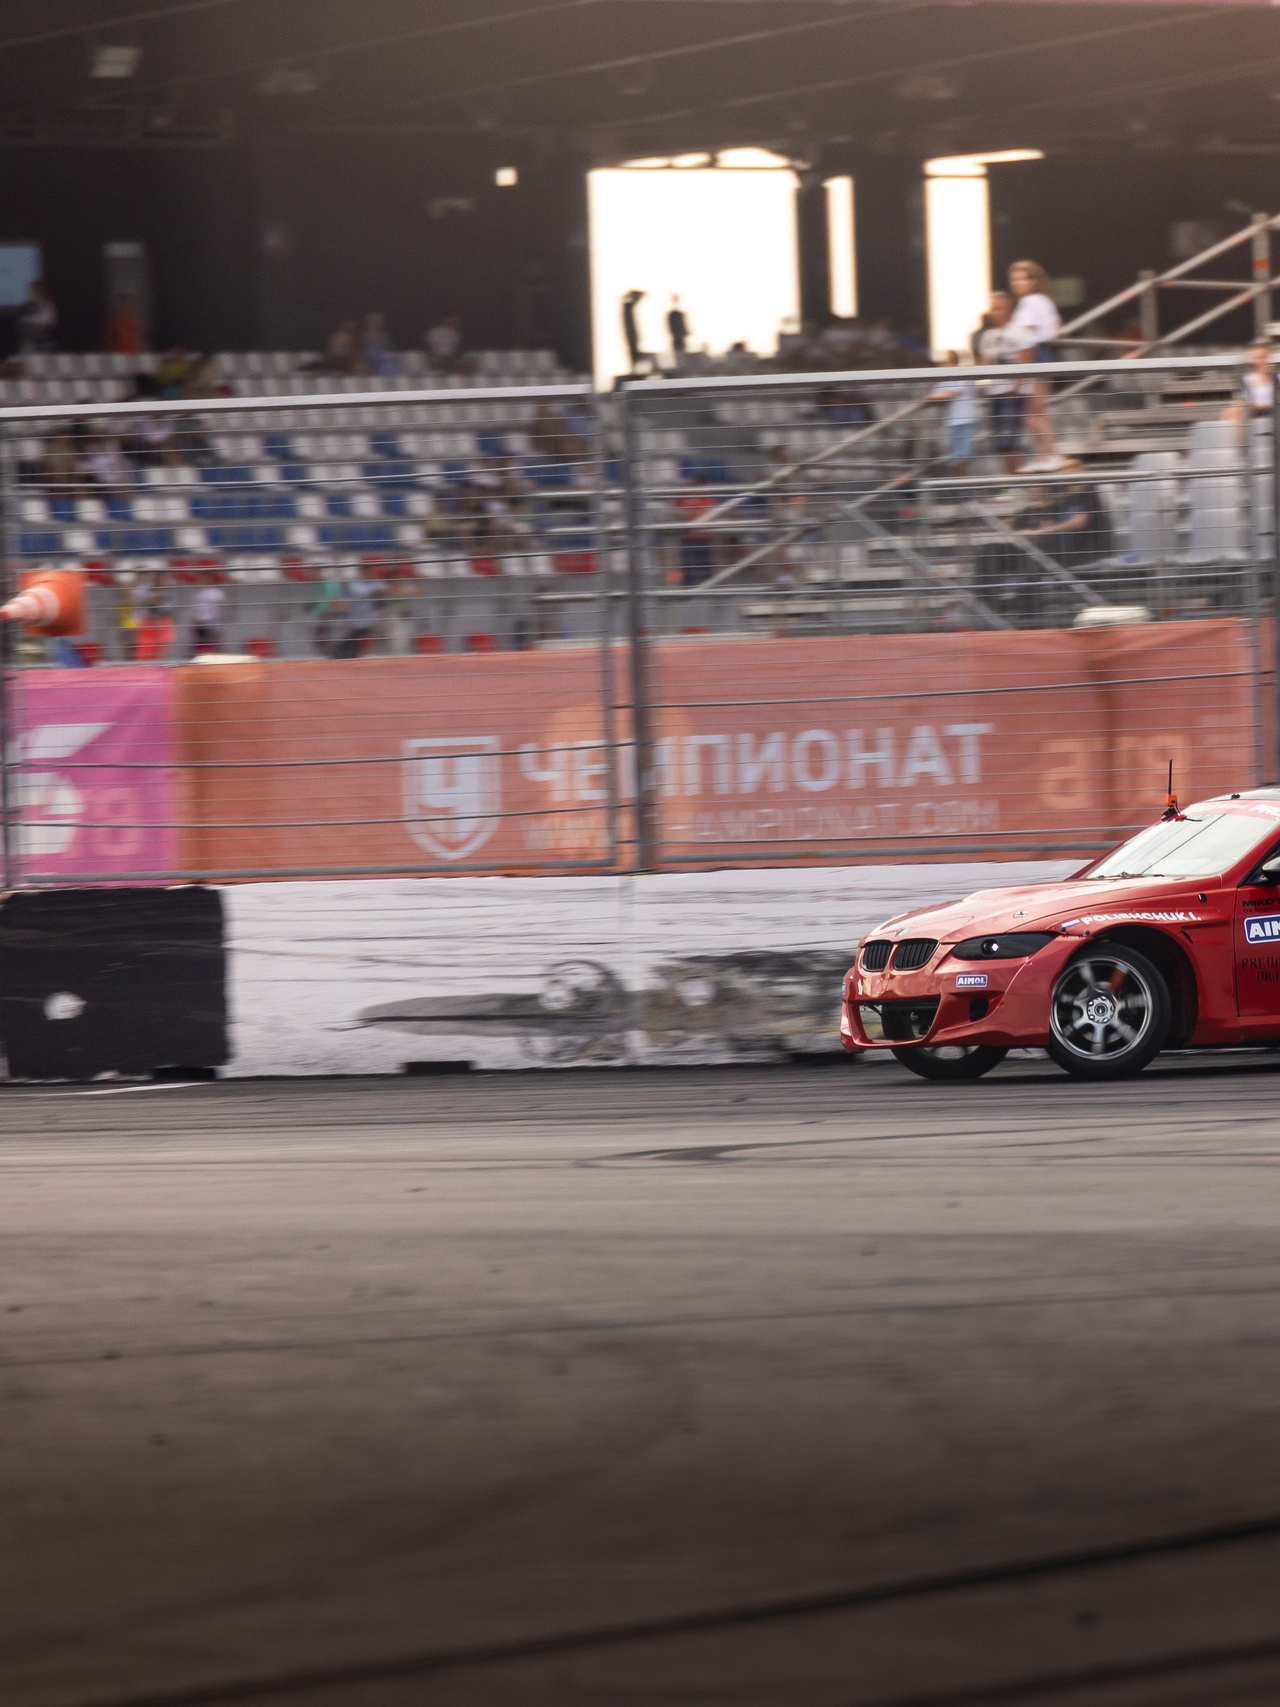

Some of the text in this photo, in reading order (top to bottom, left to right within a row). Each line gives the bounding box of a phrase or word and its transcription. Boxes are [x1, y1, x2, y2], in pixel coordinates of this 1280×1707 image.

[517, 722, 996, 803] ЧЕМПИОНАТ
[1081, 911, 1189, 926] POLISHCHUK
[957, 977, 986, 985] AIMOL
